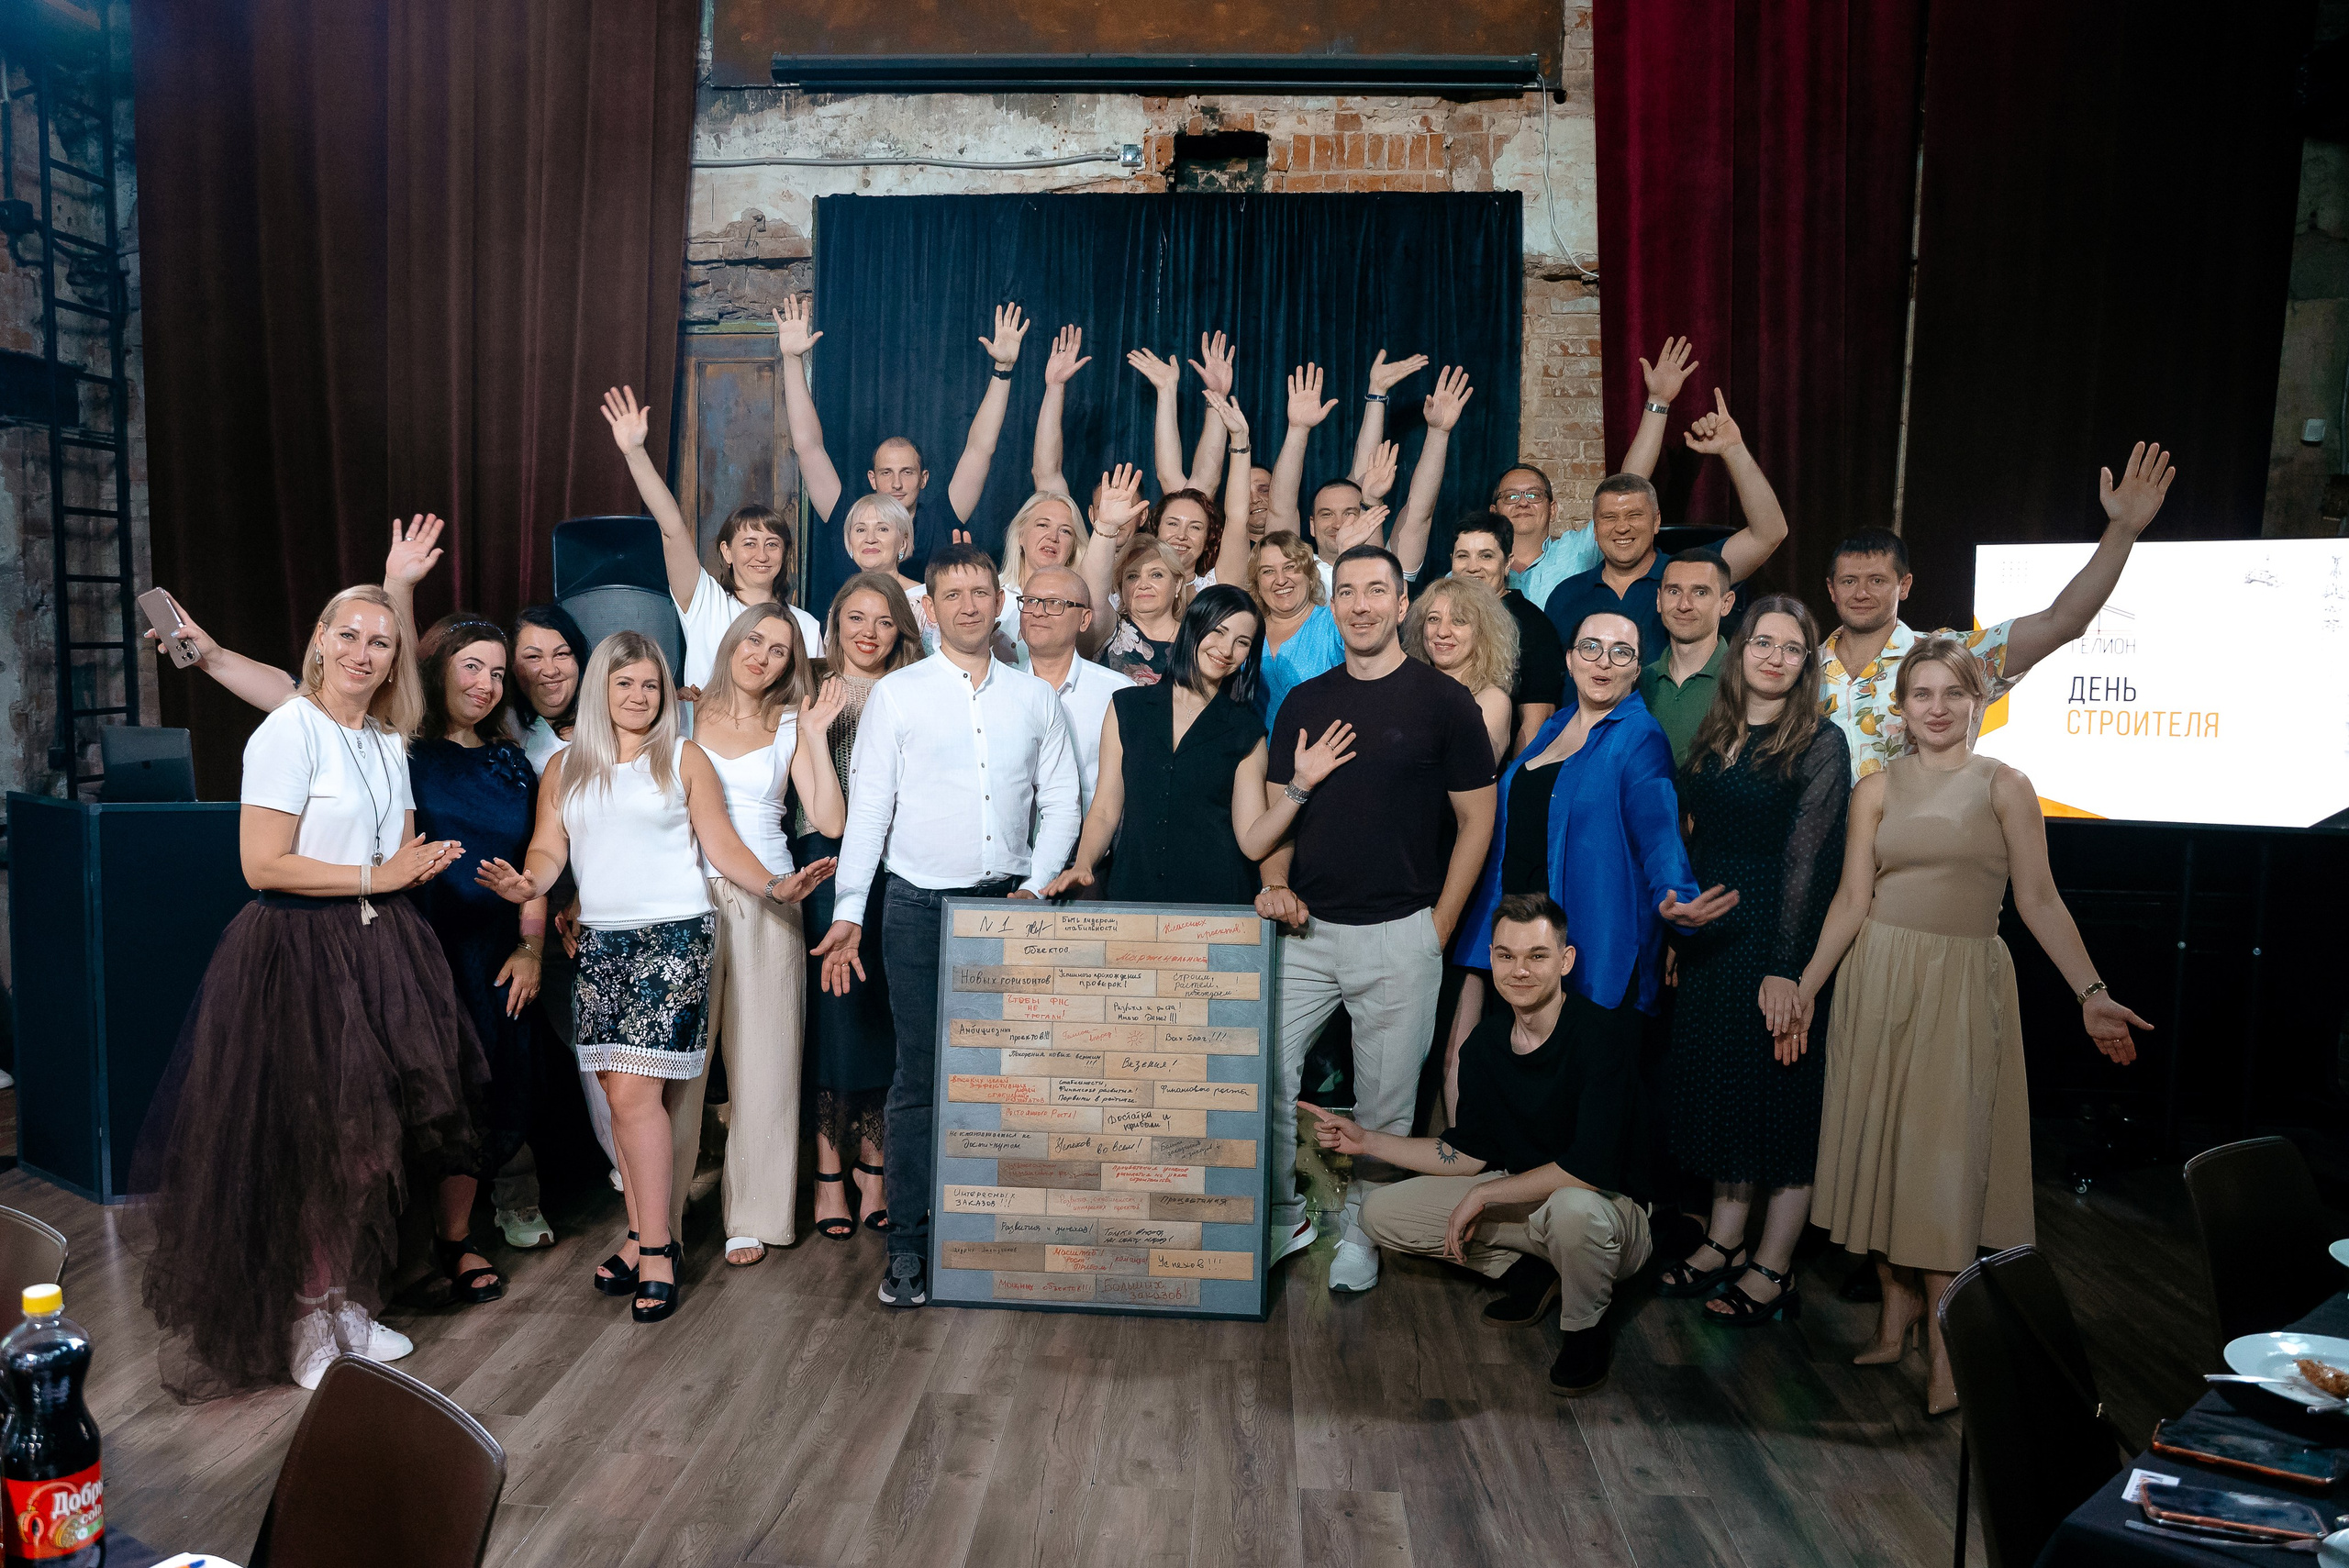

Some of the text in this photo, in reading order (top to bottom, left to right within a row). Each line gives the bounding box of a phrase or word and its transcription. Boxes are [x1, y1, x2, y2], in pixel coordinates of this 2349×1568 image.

[2068, 676, 2137, 705] ДЕНЬ
[2066, 709, 2220, 738] СТРОИТЕЛЯ
[961, 969, 1052, 985] Новых горизонтов
[1050, 997, 1070, 1006] ФНС
[1097, 1143, 1108, 1154] во
